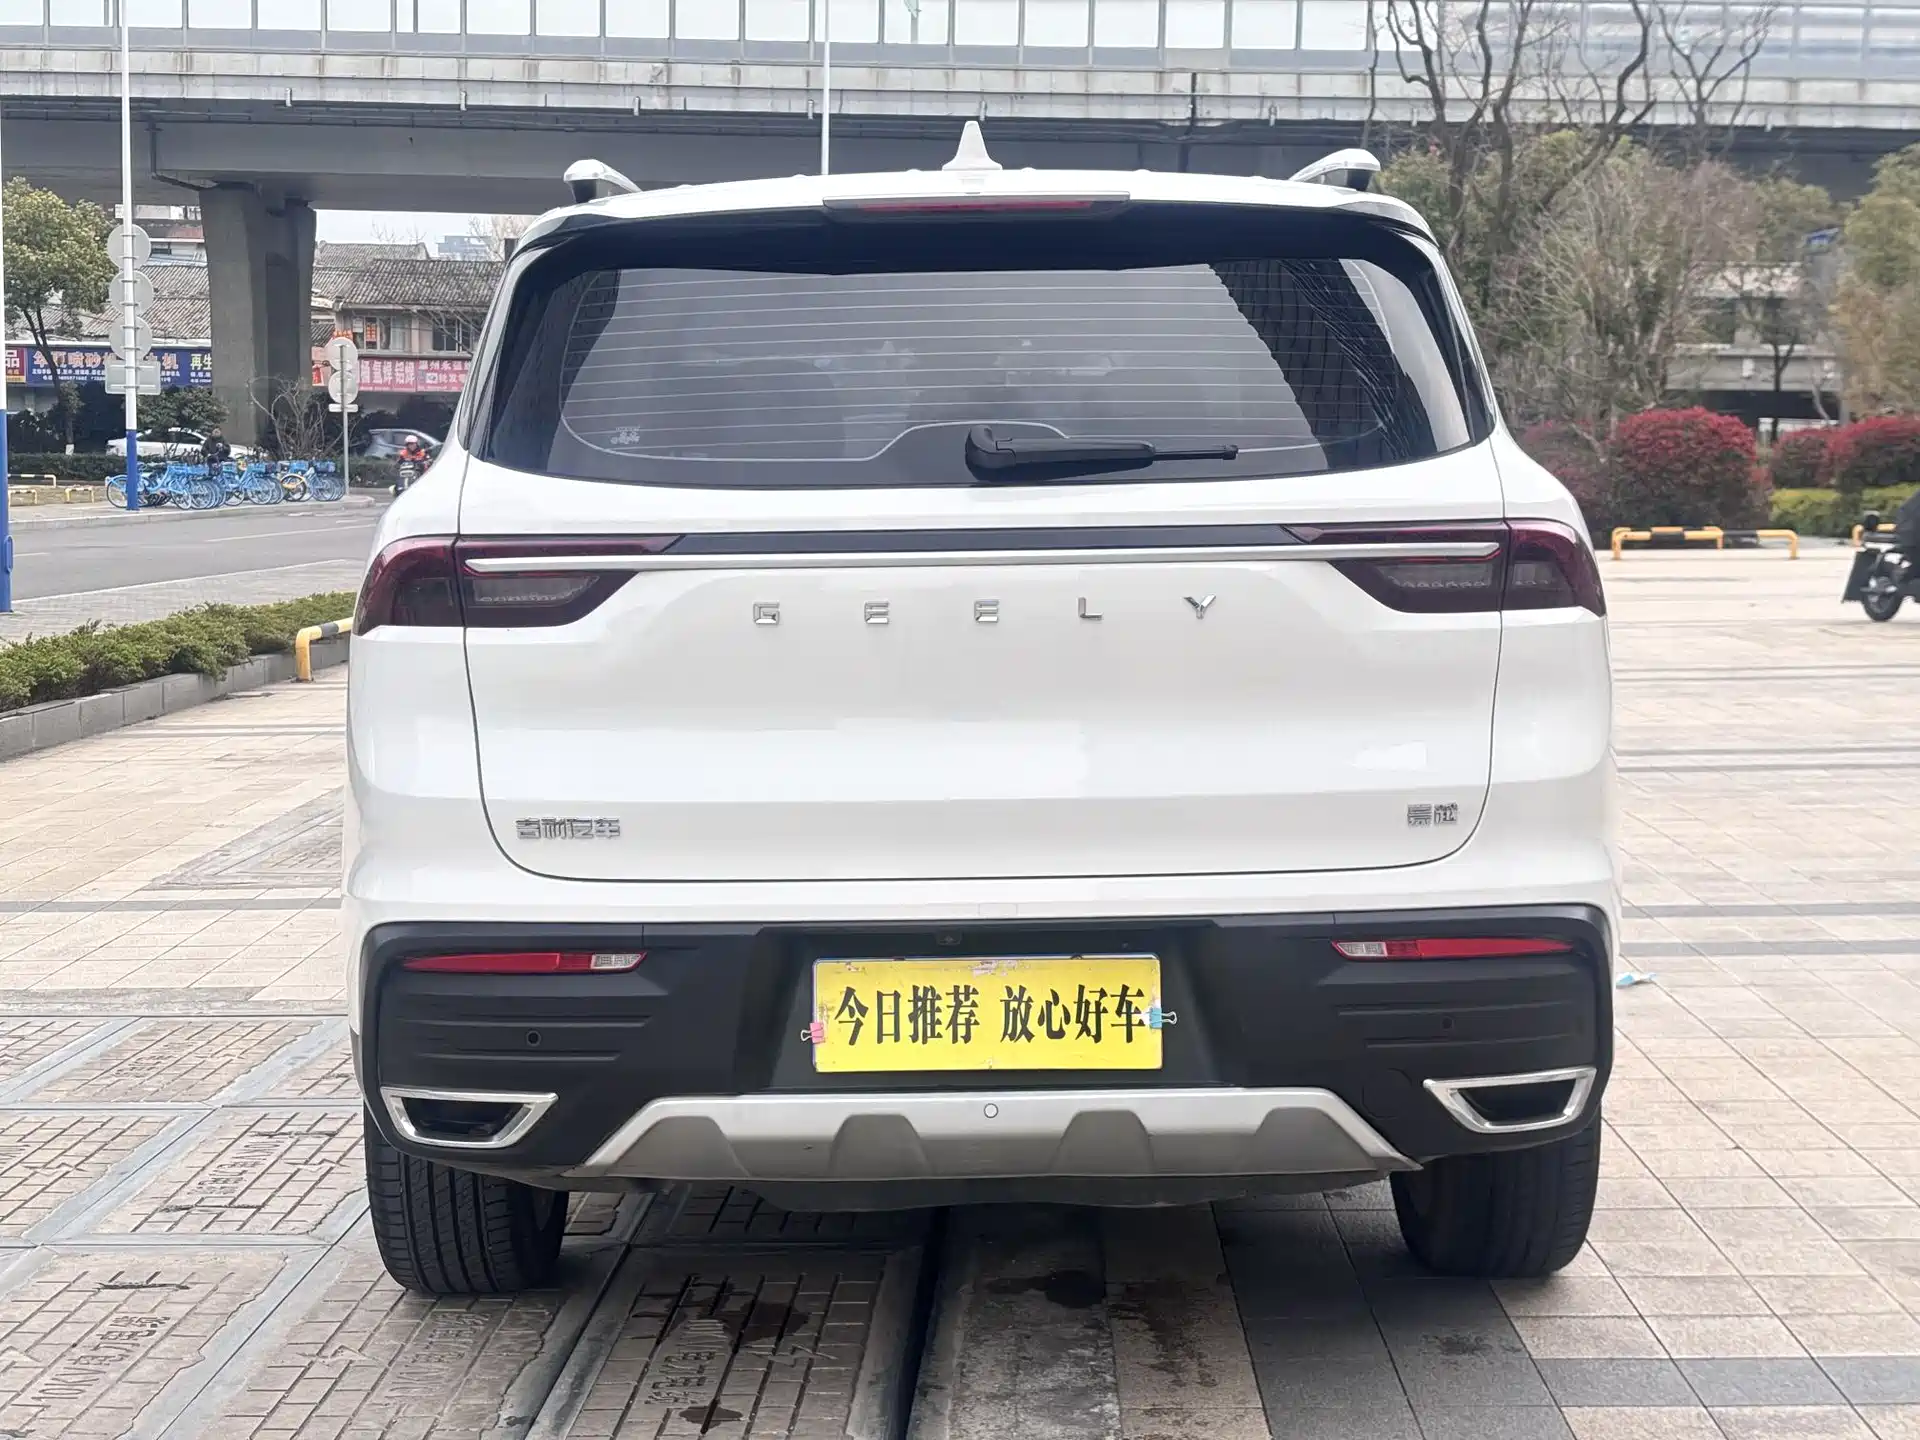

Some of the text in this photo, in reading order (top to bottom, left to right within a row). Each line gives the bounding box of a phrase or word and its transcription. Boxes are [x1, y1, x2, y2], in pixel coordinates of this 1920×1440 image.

[752, 594, 1217, 626] GEELY
[515, 817, 620, 839] 吉利汽车
[834, 984, 1146, 1046] 今日推荐 放心好车
[31, 1316, 170, 1399] 10KV电力电缆
